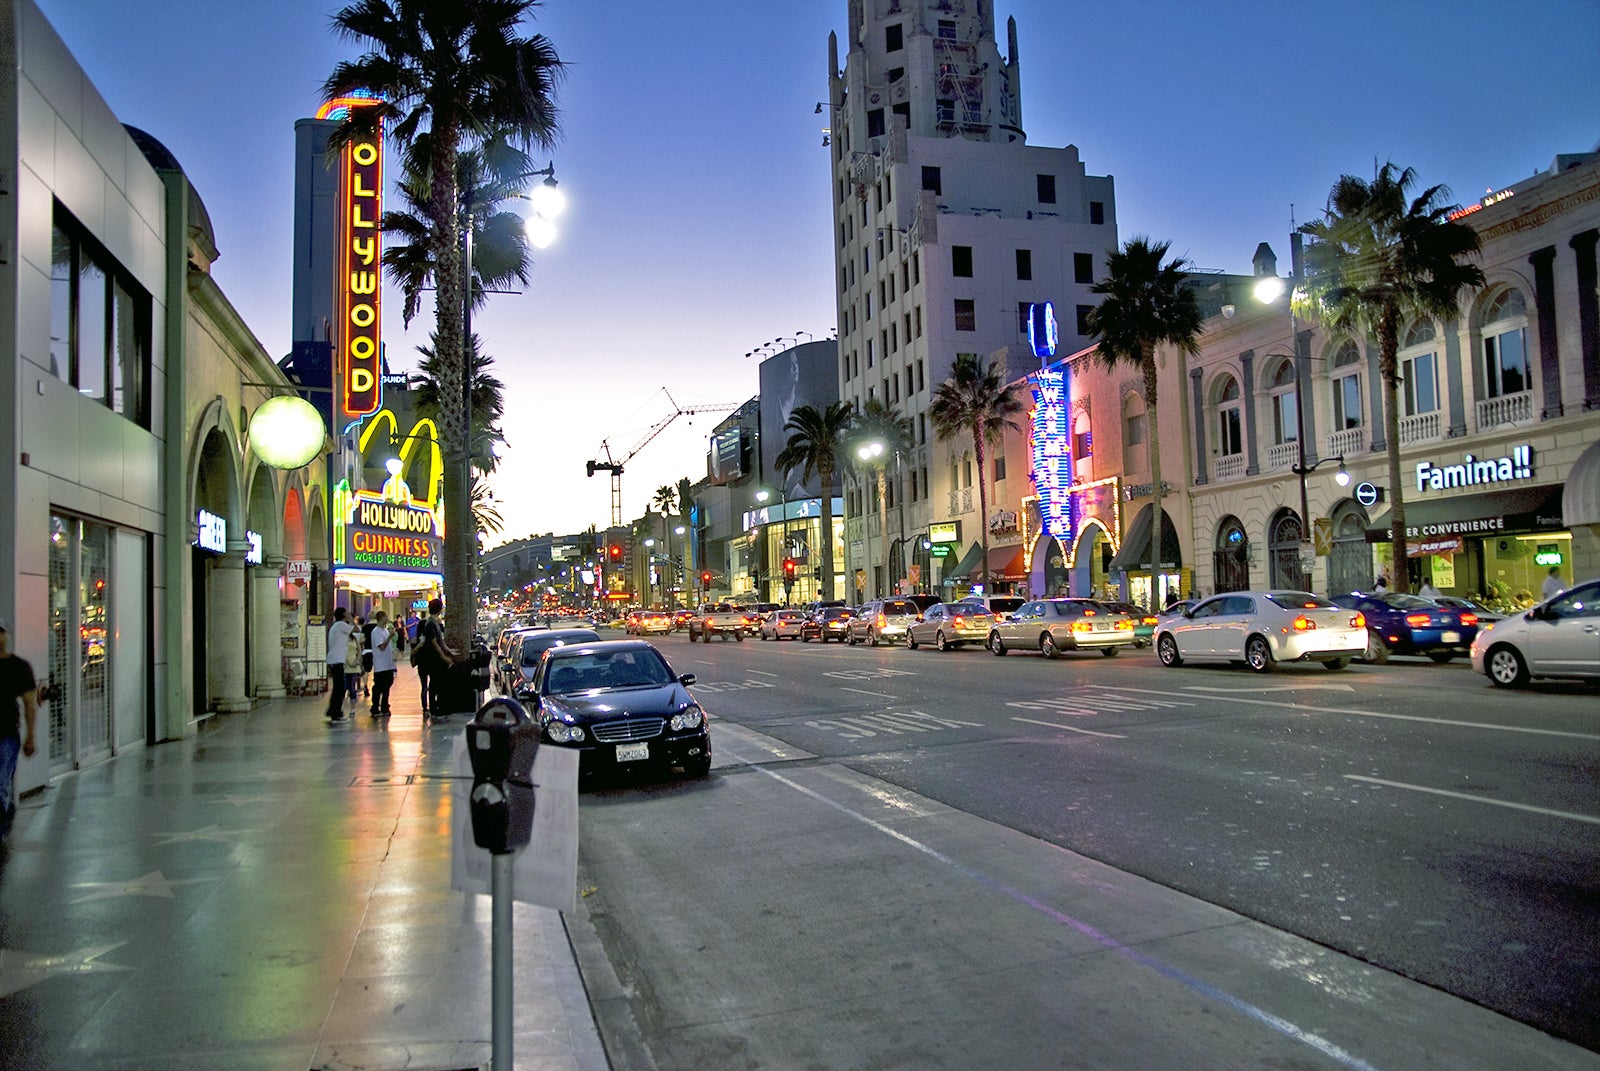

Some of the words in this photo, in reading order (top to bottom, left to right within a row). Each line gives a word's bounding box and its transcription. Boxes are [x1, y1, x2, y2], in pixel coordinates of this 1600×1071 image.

[350, 141, 378, 393] OLLYWOOD
[1416, 445, 1531, 492] Famima!!
[360, 502, 432, 533] HOLLYWOOD
[1388, 528, 1419, 540] SER
[1422, 518, 1504, 536] CONVENIENCE
[353, 531, 431, 558] GUINNESS
[1421, 543, 1439, 551] PLAY
[289, 561, 310, 572] ATM
[354, 552, 383, 564] WORLD
[386, 554, 395, 565] OF
[398, 556, 430, 568] RECORDS
